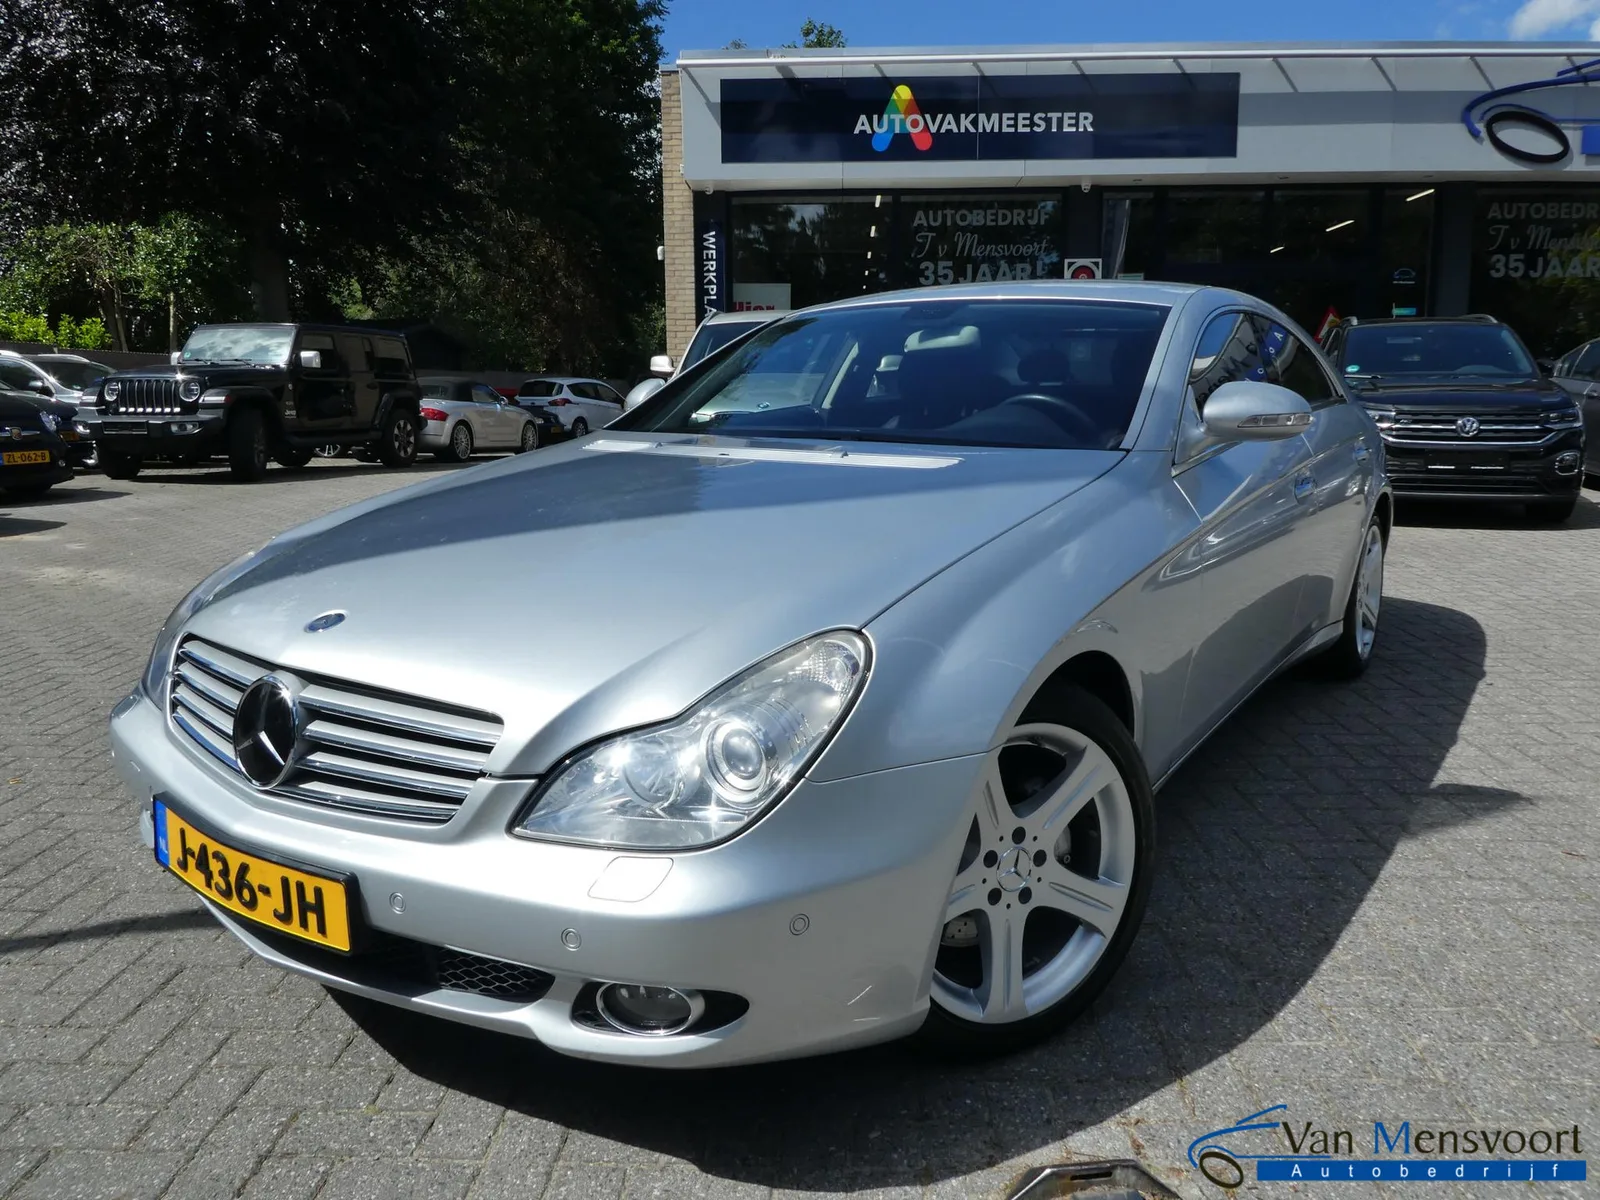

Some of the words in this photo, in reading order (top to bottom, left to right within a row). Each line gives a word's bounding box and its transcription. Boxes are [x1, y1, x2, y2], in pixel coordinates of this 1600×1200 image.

[854, 112, 1094, 134] AUTOVAKMEESTER
[913, 209, 1050, 227] AUTOBEDRIJF
[954, 231, 1049, 258] Mensvoort
[919, 261, 954, 286] 35
[1489, 254, 1525, 278] 35
[6, 452, 47, 464] ZL-062-B
[177, 827, 328, 938] J-436-JH
